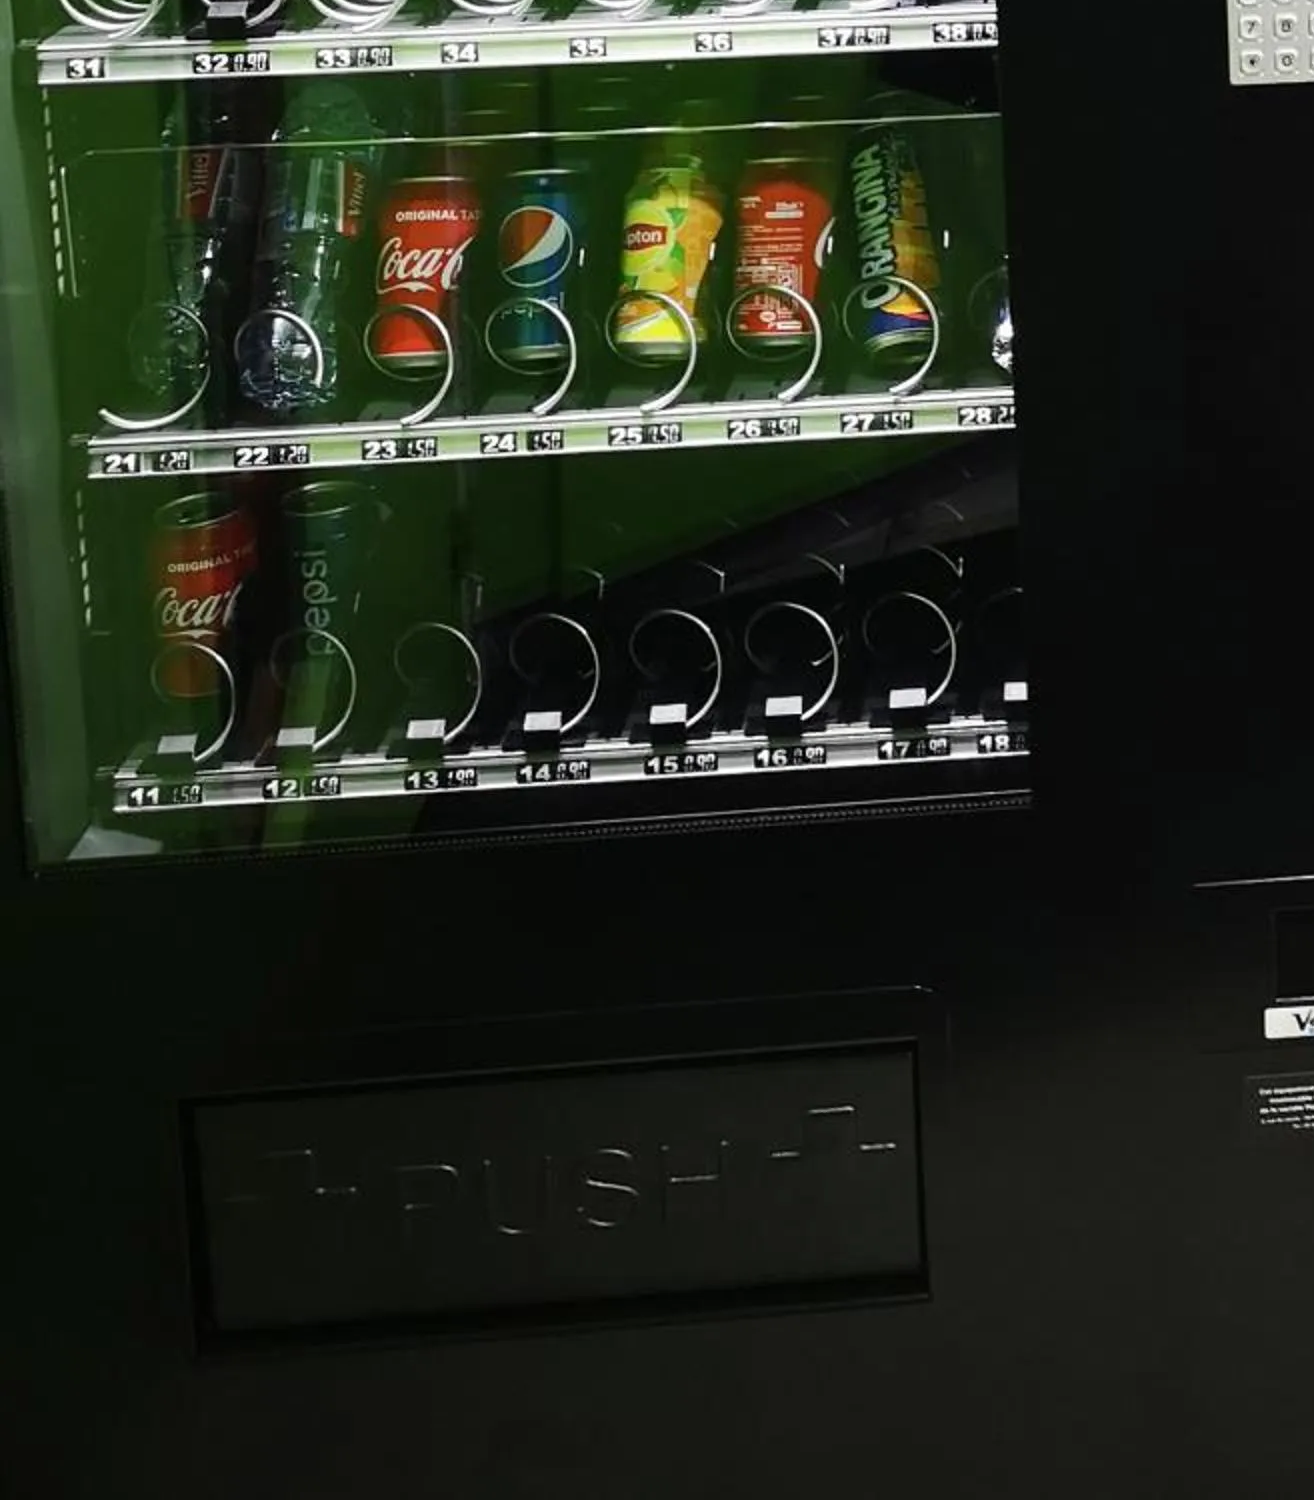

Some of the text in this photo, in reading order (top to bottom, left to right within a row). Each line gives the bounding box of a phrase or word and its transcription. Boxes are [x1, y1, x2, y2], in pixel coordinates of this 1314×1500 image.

[696, 32, 731, 52] 36
[819, 28, 853, 47] 37
[935, 23, 968, 41] 38
[442, 43, 477, 63] 34
[571, 37, 606, 57] 35
[68, 57, 102, 78] 31
[195, 52, 267, 73] 32 0.90
[317, 49, 351, 68] 33
[395, 209, 458, 222] ORIGINAL
[852, 143, 900, 309] ORANGINA
[624, 229, 662, 246] pton
[842, 413, 875, 433] 27
[959, 406, 992, 426] 28
[609, 426, 643, 446] 25
[729, 419, 761, 439] 26
[364, 440, 398, 460] 23
[482, 434, 516, 453] 24
[104, 453, 138, 473] 21
[235, 446, 269, 466] 22
[167, 554, 232, 573] ORIGINAL
[879, 740, 911, 759] 17
[978, 734, 1010, 753] 18
[647, 755, 680, 774] 15
[756, 749, 788, 768] 16
[407, 771, 440, 790] 13
[519, 763, 552, 783] 14
[130, 786, 160, 805] 11
[264, 779, 298, 799] 12
